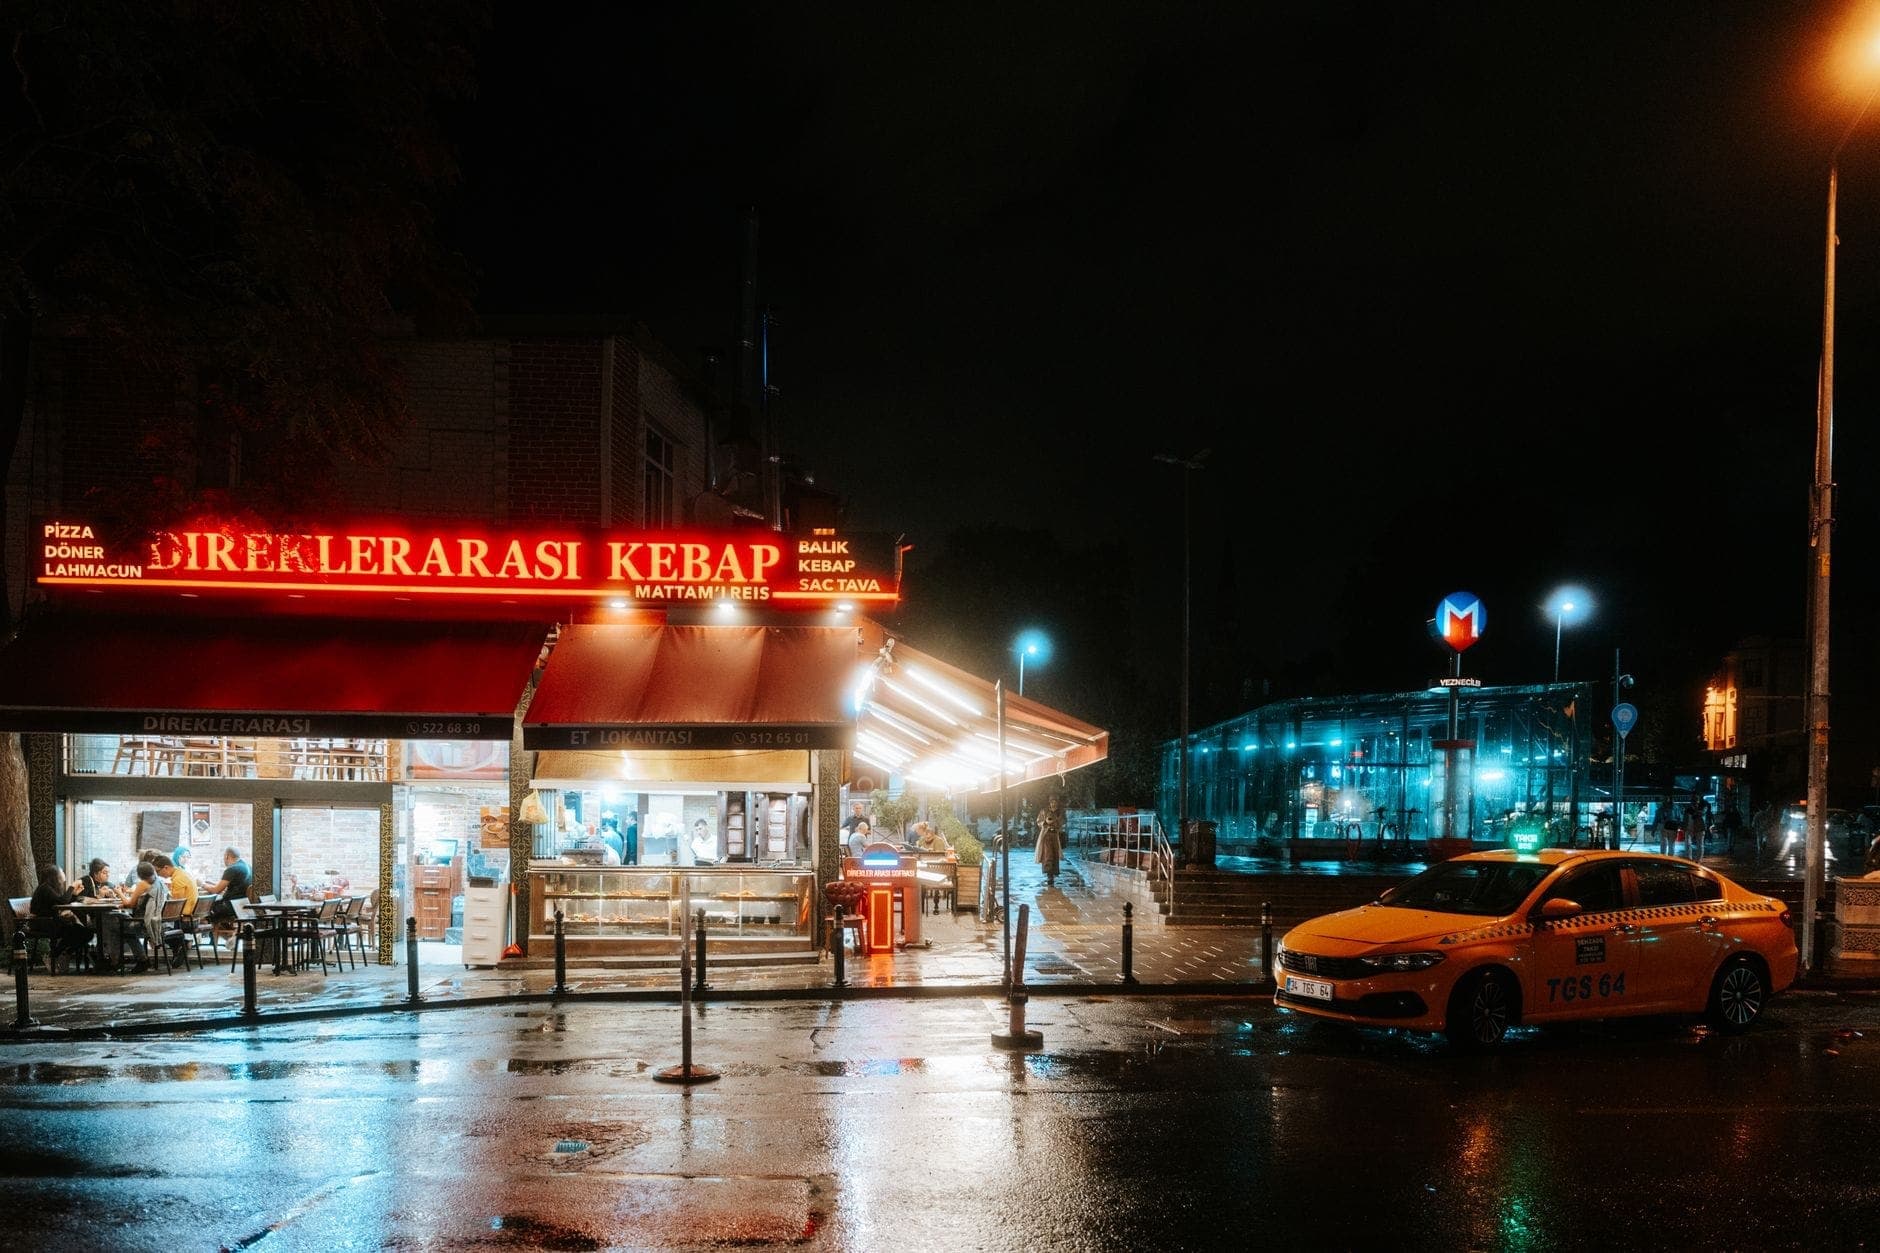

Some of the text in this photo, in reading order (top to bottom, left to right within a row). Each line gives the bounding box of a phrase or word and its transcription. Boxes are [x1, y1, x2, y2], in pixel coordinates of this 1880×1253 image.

[44, 521, 95, 539] PİZZA
[44, 542, 105, 559] DÖNER
[798, 540, 849, 554] BALIK
[45, 563, 143, 578] LAHMACUN
[606, 542, 781, 583] KEBAP
[798, 559, 856, 573] KEBAP
[798, 578, 881, 592] SAC TAVA
[1443, 599, 1480, 638] M
[143, 714, 311, 734] DİREKLERARASI
[422, 722, 481, 734] 522 68 30
[570, 730, 693, 745] ET LOKANTASI
[750, 732, 810, 744] 512 65 01
[1290, 979, 1330, 997] 34 TGS 64
[1547, 971, 1625, 1003] TGS 64
